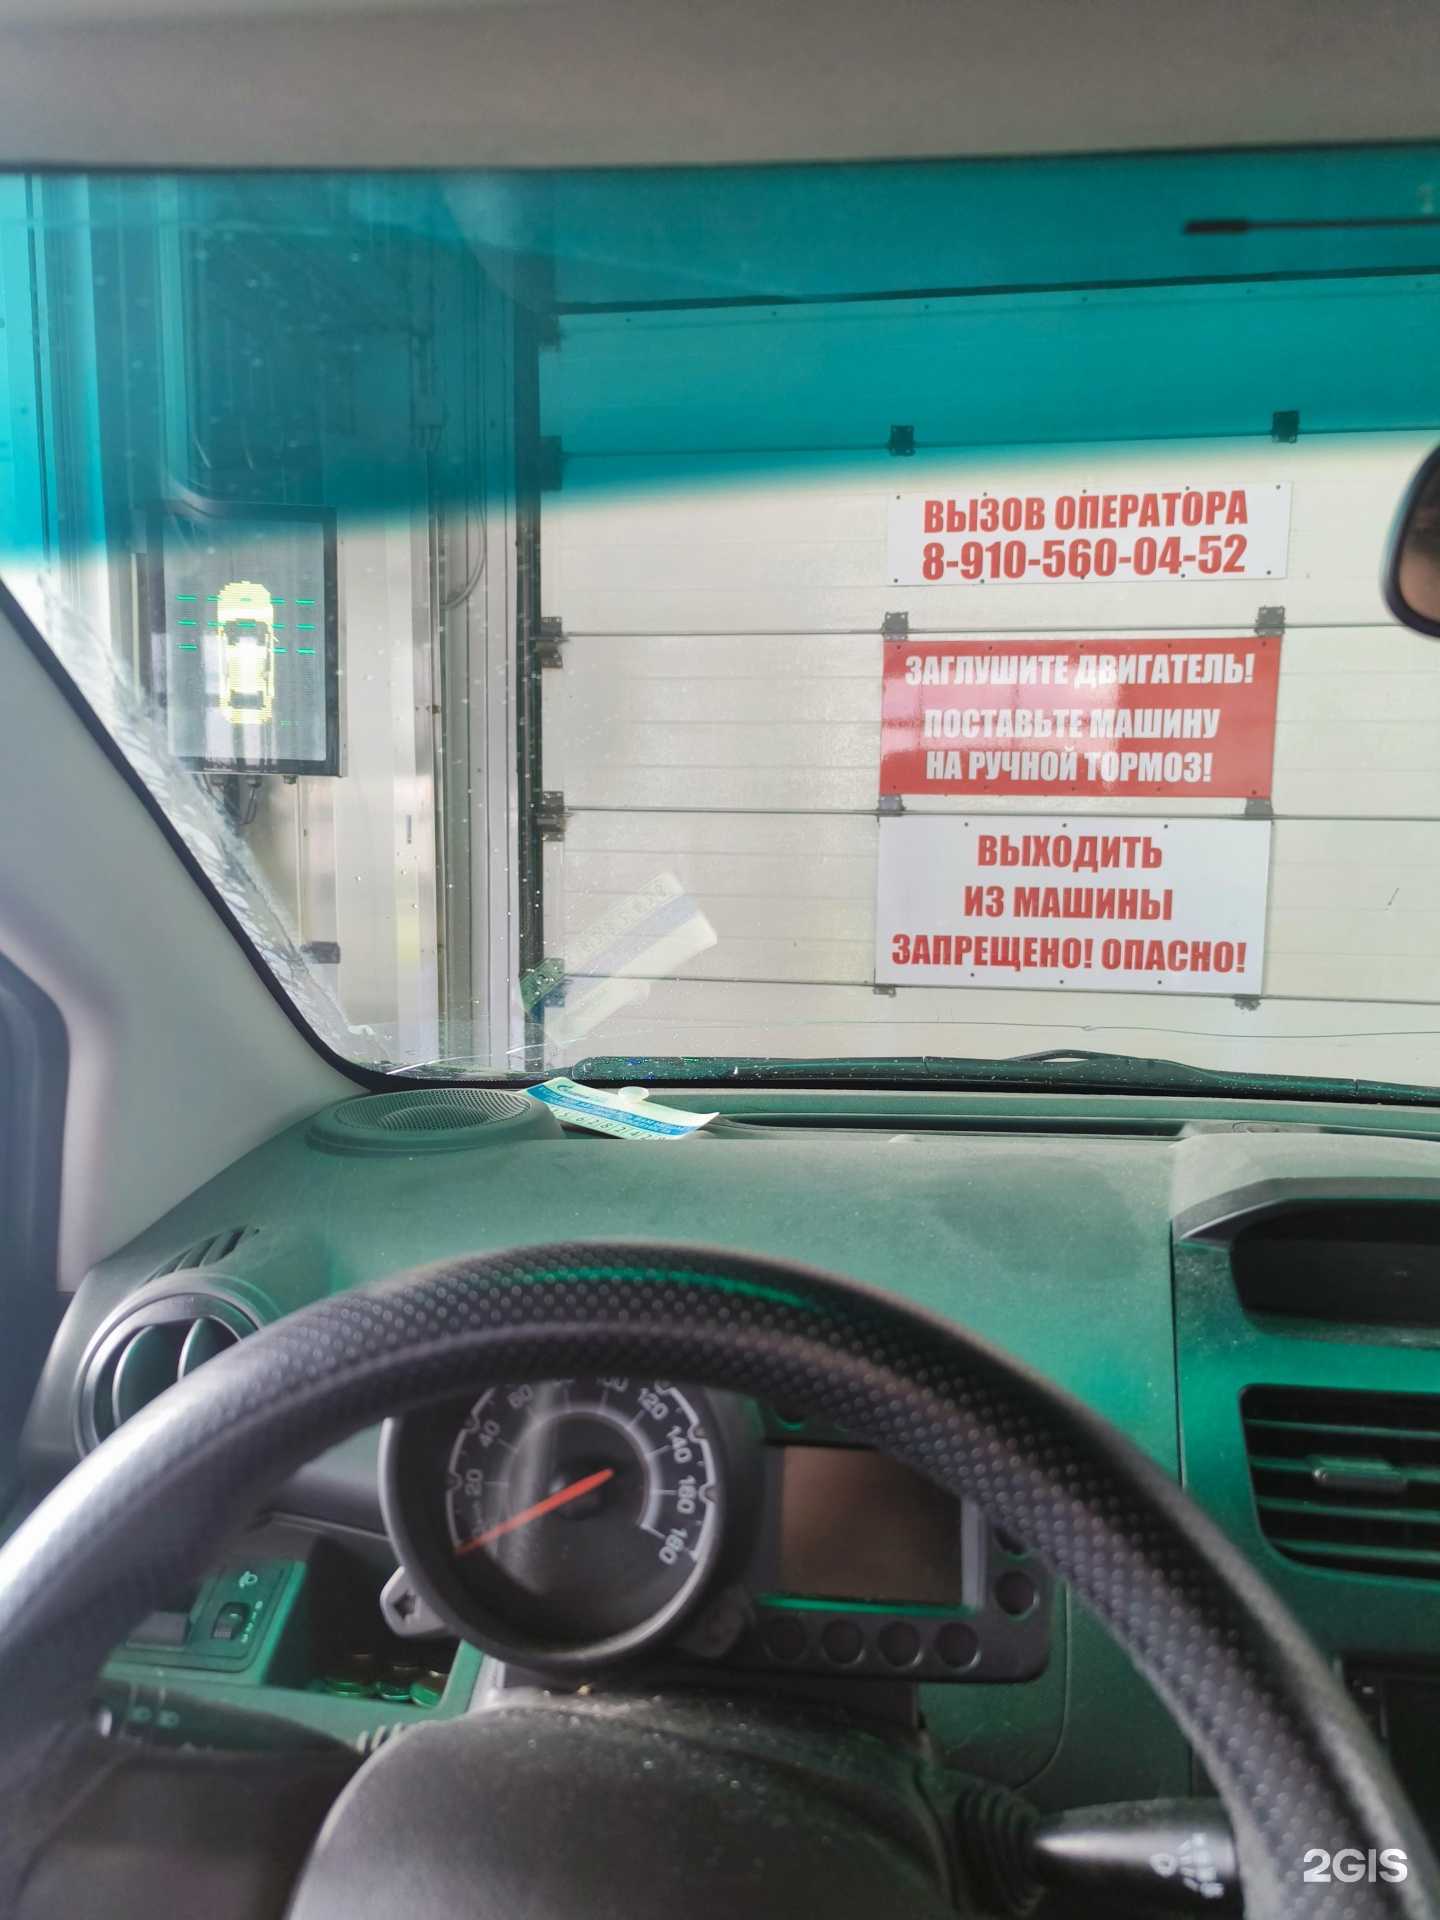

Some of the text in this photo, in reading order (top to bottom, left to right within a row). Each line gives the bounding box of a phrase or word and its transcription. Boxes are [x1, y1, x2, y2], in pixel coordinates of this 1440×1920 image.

[924, 490, 1248, 533] ВЫЗОВ ОПЕРАТОРА
[923, 534, 1248, 581] 8-910-560-04-52
[905, 653, 1255, 689] ЗАГЛУШИТЕ ДВИГАТЕЛЬ!
[924, 708, 1221, 739] ПОСТАВЬТЕ МАШИНУ
[926, 745, 1213, 783] НА РУЧНОЙ ТОРМОЗ!
[978, 835, 1162, 873] ВЫХОДИТЬ
[964, 886, 1173, 920] ИЗ МАШИНЫ
[892, 934, 1247, 973] ЗАПРЕЩЕНО! ОПАСНО!
[667, 1425, 692, 1463] 140
